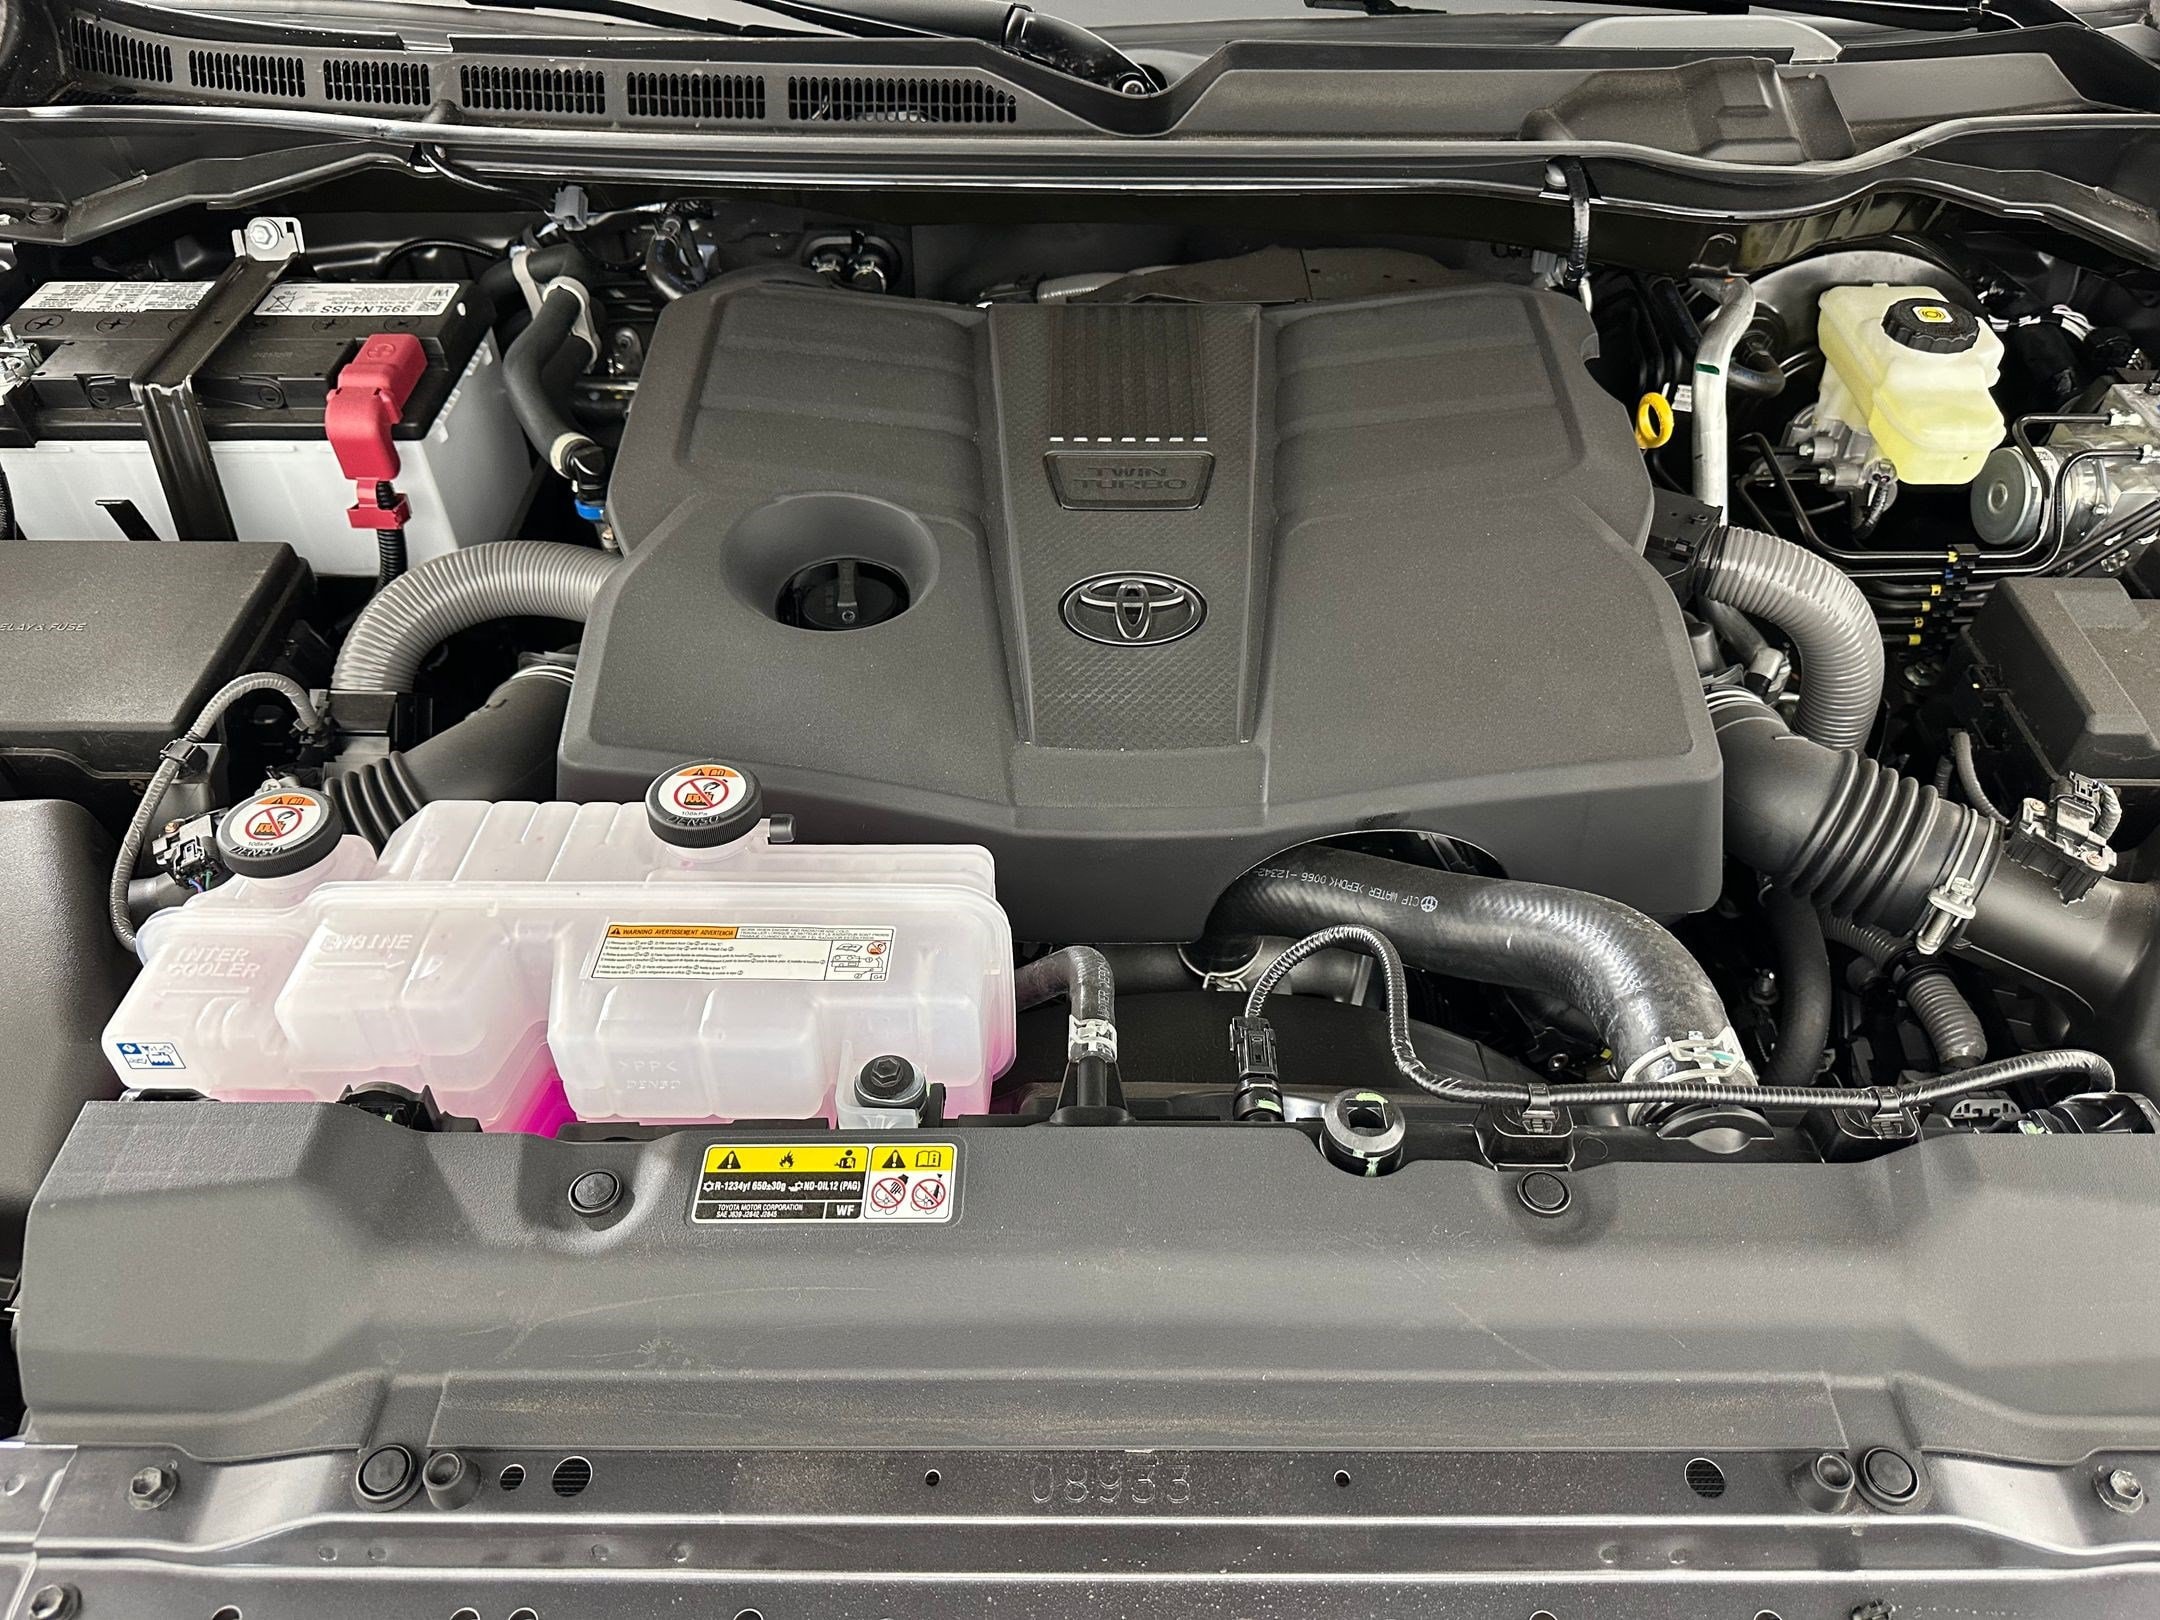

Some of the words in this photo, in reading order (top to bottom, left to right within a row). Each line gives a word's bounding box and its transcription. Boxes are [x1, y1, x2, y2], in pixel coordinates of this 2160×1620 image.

[320, 304, 412, 314] 395LN4-ISS
[1087, 466, 1168, 477] TWIN
[1073, 479, 1188, 490] TURBO
[48, 621, 88, 632] FUSE
[665, 815, 719, 826] DENSO
[229, 845, 282, 858] DENSO
[1301, 871, 1327, 884] 0066
[1368, 885, 1398, 903] WATER
[654, 928, 699, 936] AVERTISSEMENT
[700, 928, 734, 937] ADVERTENCIA
[319, 933, 413, 950] ENGINE
[175, 946, 251, 963] INTER
[167, 962, 261, 979] COOLER
[714, 1180, 751, 1193] R-1234yf
[839, 1180, 861, 1192] (PAG)
[716, 1210, 728, 1218] SAE
[718, 1203, 740, 1212] TOYOTA
[741, 1203, 762, 1212] MOTOR
[762, 1203, 804, 1212] CORPORATION
[836, 1204, 855, 1217] WF
[1030, 1463, 1191, 1504] 08933
